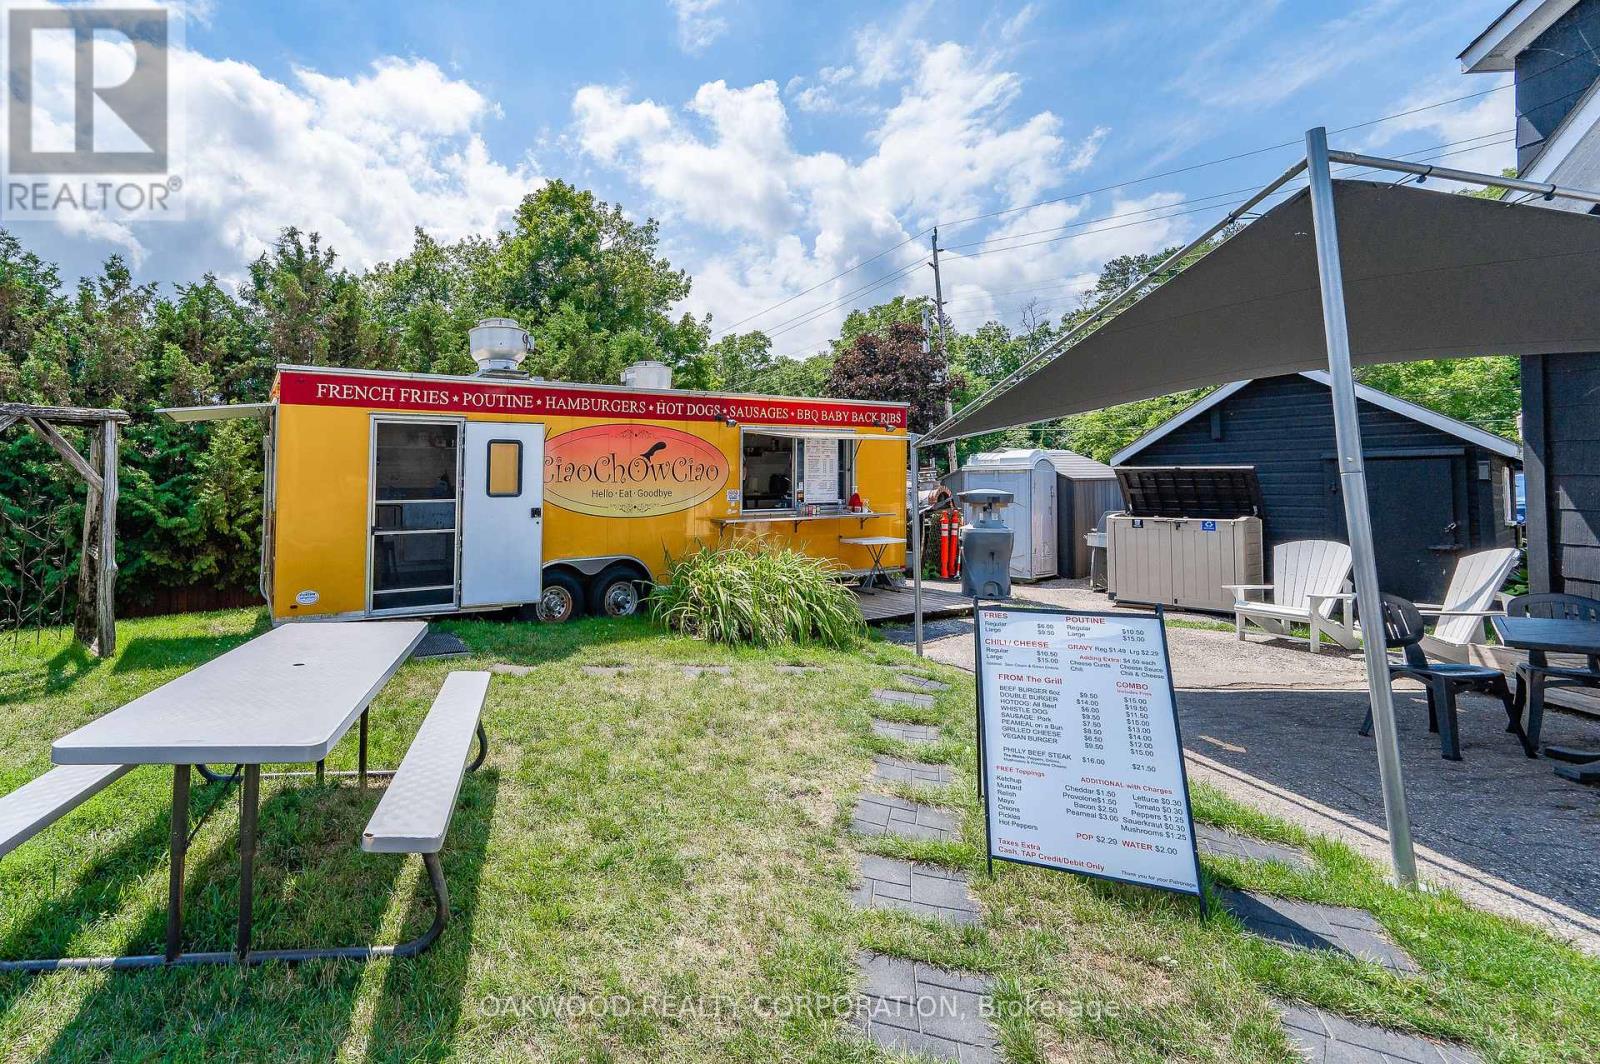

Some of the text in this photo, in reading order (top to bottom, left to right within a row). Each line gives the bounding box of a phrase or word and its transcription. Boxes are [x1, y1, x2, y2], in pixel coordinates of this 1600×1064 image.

[316, 383, 901, 424] FRENCH FRIES POUTINE HAMBURGERS HOT DOGS SAUSAGES BBQ BABY BACK RIBS
[591, 489, 673, 499] Hello Eat Goodbye
[985, 638, 1006, 646] CHILI
[1013, 640, 1048, 648] CHEESE
[998, 673, 1024, 681] FROM
[1044, 677, 1062, 685] Grill
[1018, 686, 1047, 694] BURGER
[1116, 681, 1148, 690] COMBO
[1000, 692, 1027, 700] DOUBLE
[1029, 694, 1058, 702] BURGER
[1001, 705, 1030, 713] WHISTLE
[1126, 711, 1148, 719] $11.50
[1082, 720, 1101, 728] $7.50
[1001, 718, 1033, 727] PEAMEAL
[1128, 733, 1152, 742] $14.00
[1001, 726, 1031, 734] GRILLED
[1032, 729, 1061, 737] CHEESE
[1002, 732, 1026, 740] VEGAN
[1027, 735, 1058, 744] BURGER
[1003, 746, 1026, 754] PHILLY
[1048, 752, 1072, 760] STEAK
[1082, 757, 1105, 765] $16.00
[1132, 763, 1156, 772] $21.50
[1015, 767, 1045, 777] Toppings
[997, 775, 1021, 784] Ketchup
[997, 782, 1021, 790] Mustard
[1065, 784, 1115, 797] Cheddar $1.50
[1080, 777, 1124, 788] ADDITIONAL
[1142, 785, 1173, 795] Charges
[997, 789, 1016, 797] Relish
[998, 796, 1015, 805] Mayo
[1132, 794, 1182, 807] Lettuce $0.30
[998, 804, 1020, 812] Onions
[1073, 801, 1118, 814] Bacon $2.50
[1134, 802, 1183, 815] Tomato $0.30
[998, 811, 1020, 820] Pickles
[1066, 808, 1119, 822] Peameal $3.00
[1131, 809, 1184, 824] Peppers $1.25
[1011, 821, 1038, 830] Peppers
[1122, 816, 1185, 832] Sauerkraut $0.30
[1120, 824, 1186, 841] Mushrooms $1.25
[998, 837, 1040, 851] Taxes Extra
[1076, 832, 1093, 841] POP
[1121, 840, 1153, 851] WATER
[1154, 845, 1178, 855] $2.00
[1021, 850, 1037, 858] TAP
[1085, 862, 1105, 871] Only
